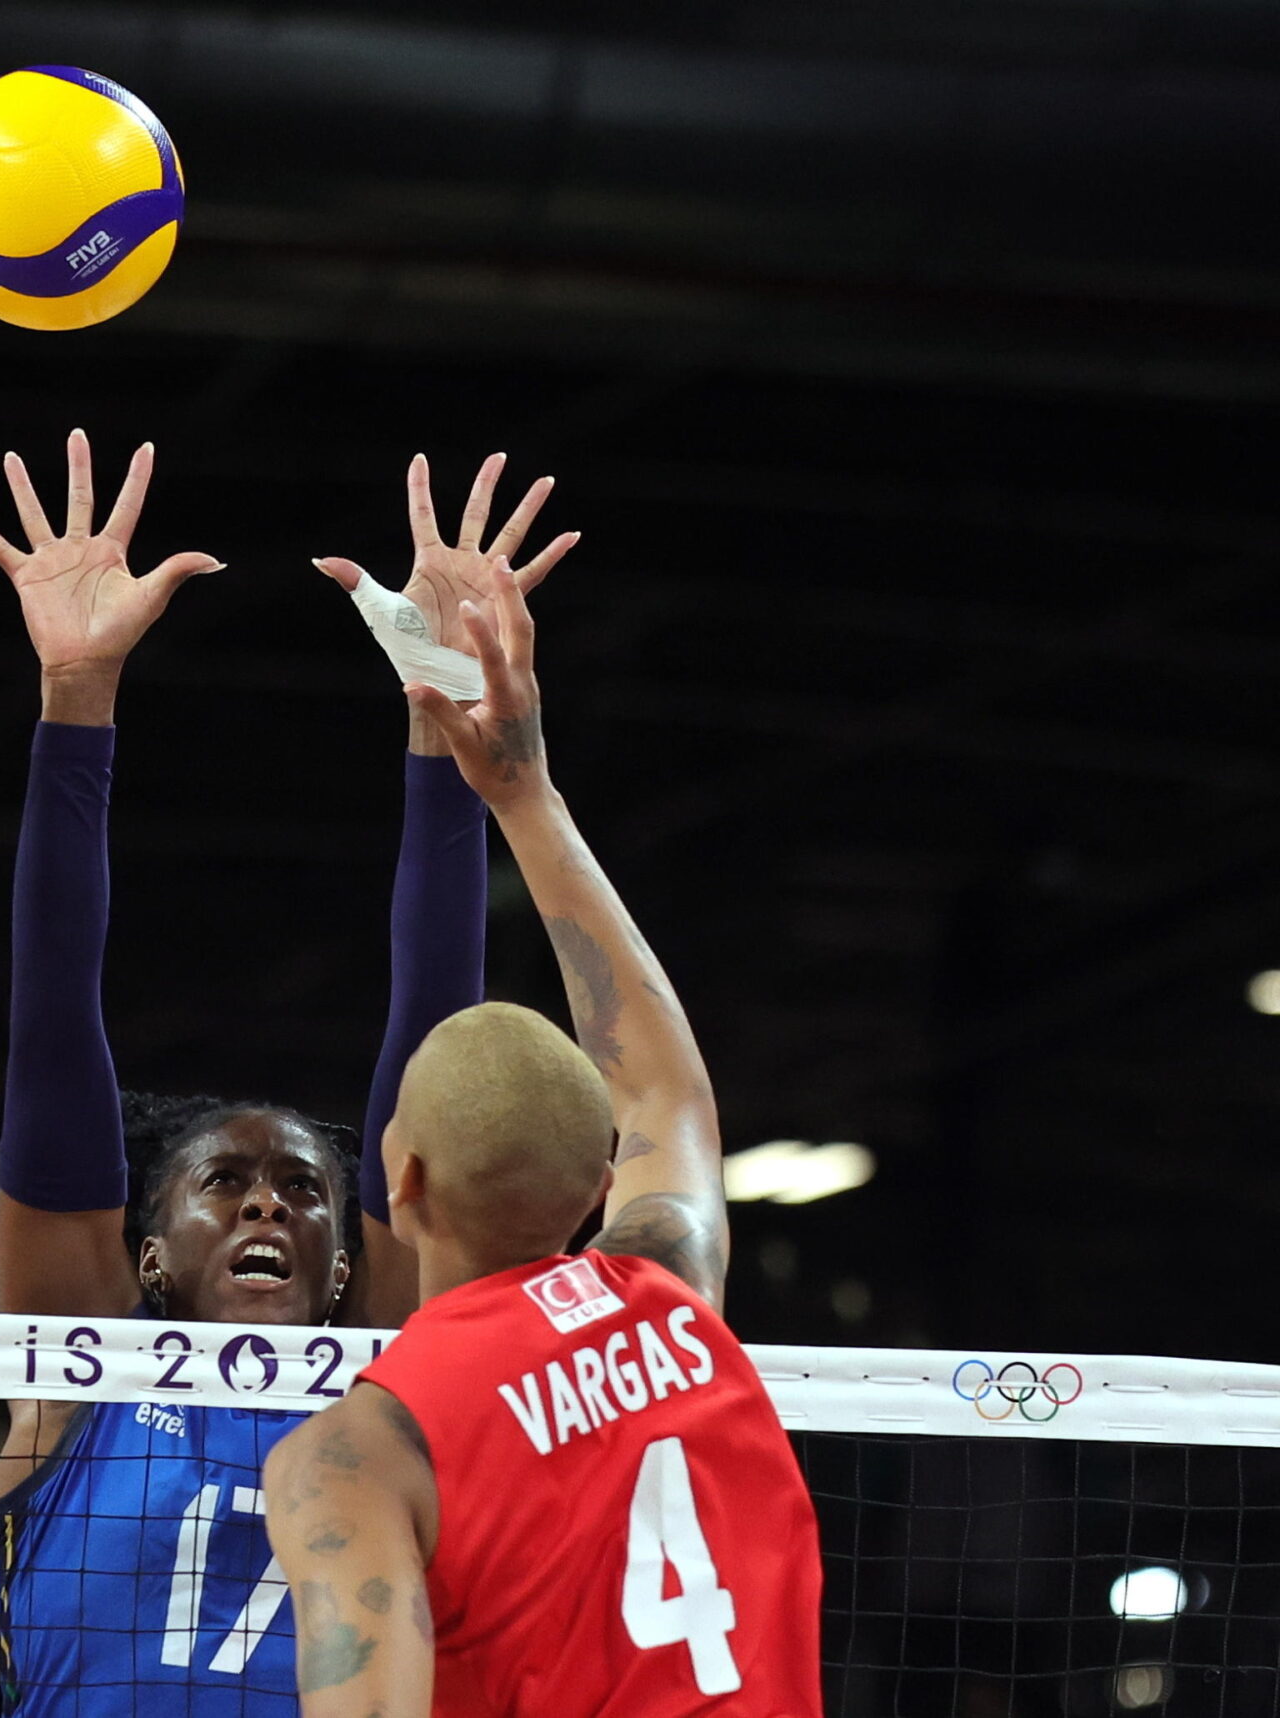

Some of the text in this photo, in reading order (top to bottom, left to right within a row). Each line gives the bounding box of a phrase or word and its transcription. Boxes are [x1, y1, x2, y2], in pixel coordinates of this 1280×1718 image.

[65, 230, 111, 270] FIVB
[152, 1330, 382, 1398] 202
[567, 1302, 605, 1323] TUR
[497, 1305, 714, 1455] VARGAS
[160, 1484, 290, 1674] 17
[622, 1436, 742, 1696] 4
